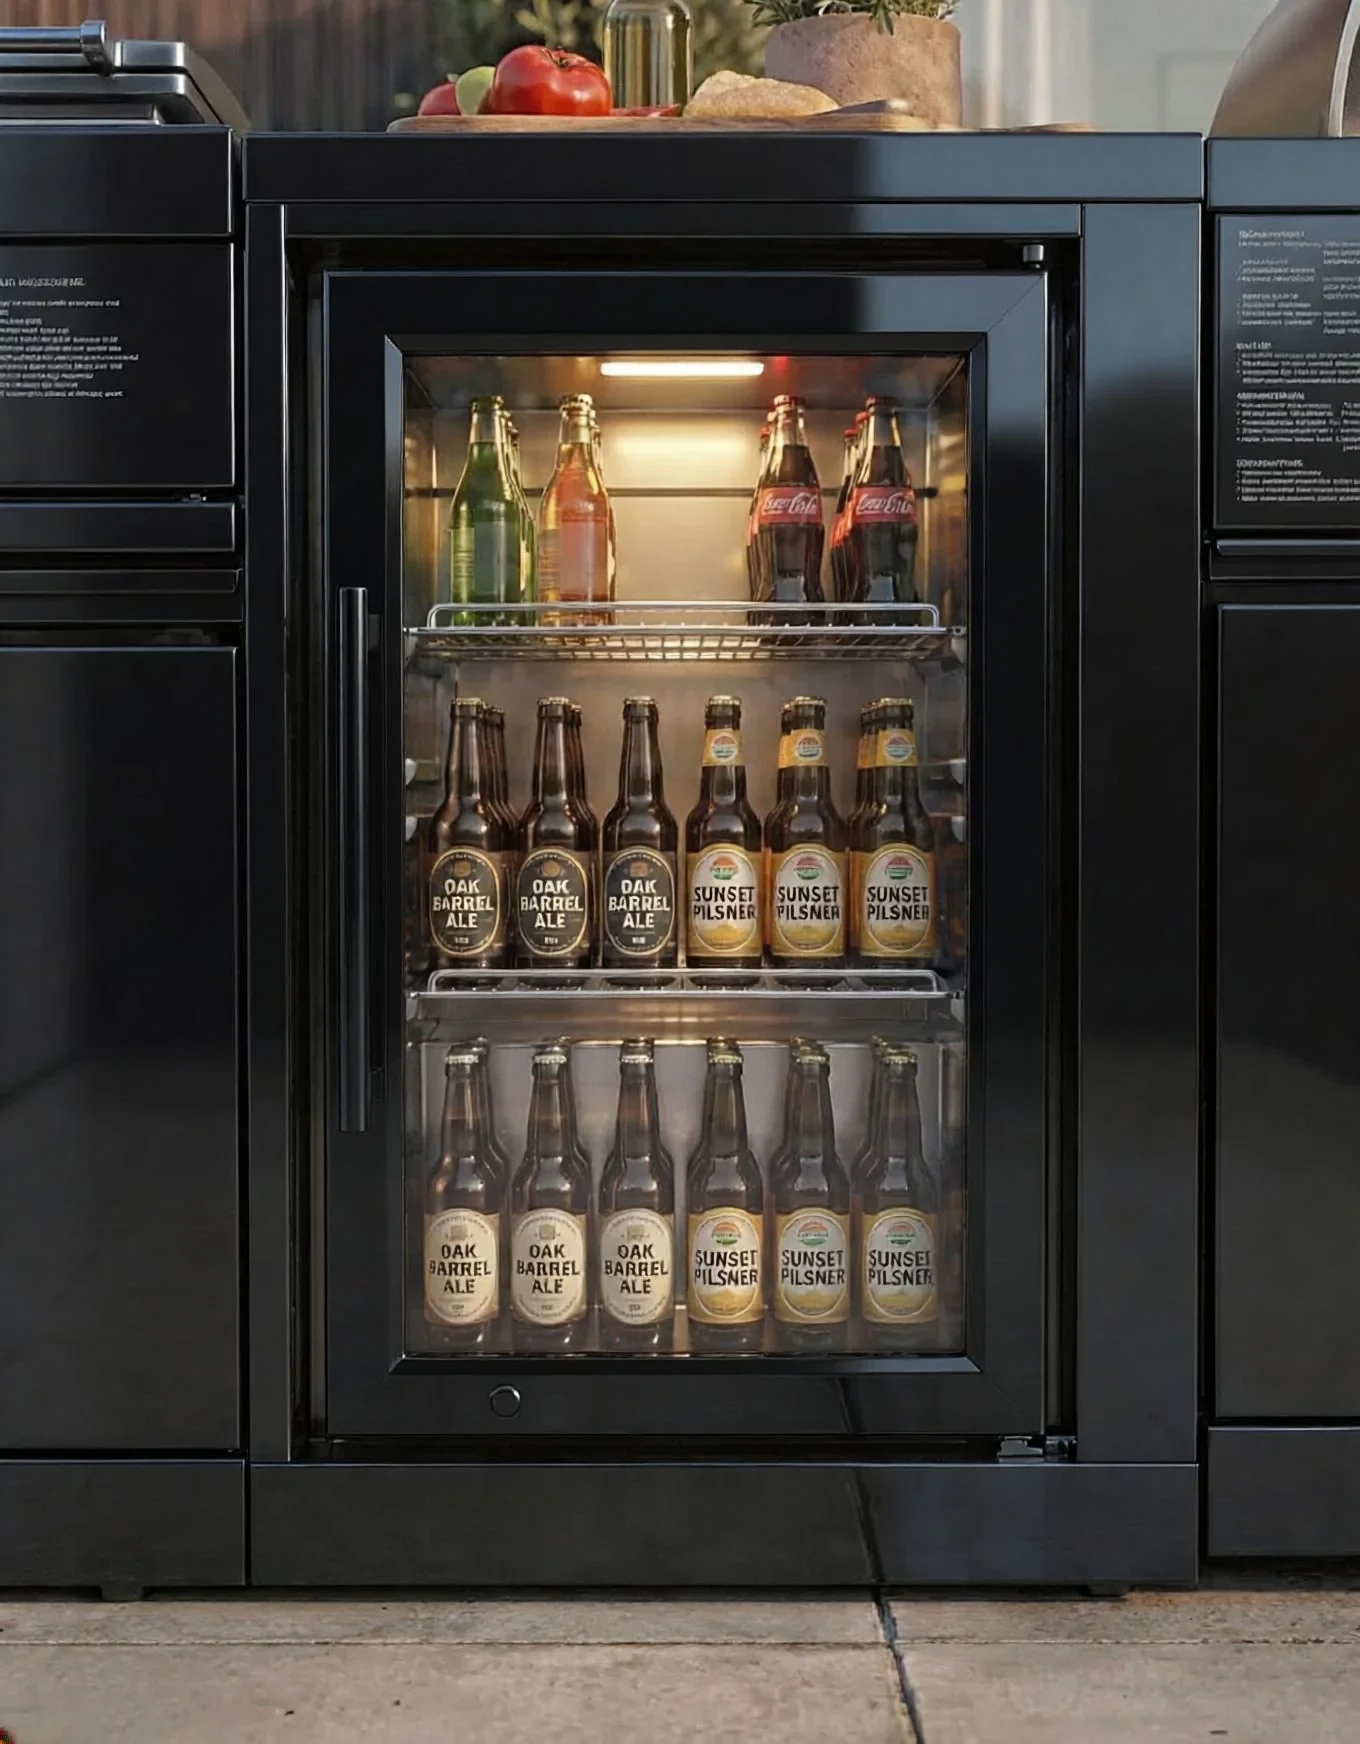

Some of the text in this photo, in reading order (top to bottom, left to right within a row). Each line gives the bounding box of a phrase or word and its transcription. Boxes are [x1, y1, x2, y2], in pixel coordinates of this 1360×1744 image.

[444, 879, 481, 894] OAK
[533, 879, 570, 894] OAK
[621, 879, 657, 894] OAK
[694, 886, 754, 902] SUNSET
[778, 886, 839, 902] SUNSET
[867, 886, 928, 902] SUNSET
[433, 896, 494, 912] BARREL
[521, 896, 583, 912] BARREL
[608, 896, 670, 912] BARREL
[694, 904, 756, 920] PILSNER
[778, 904, 840, 920] PILSNER
[868, 904, 929, 920] PILSNER
[446, 913, 478, 928] ALE
[534, 913, 566, 928] ALE
[623, 913, 655, 928] ALE
[441, 1244, 477, 1259] OAK
[529, 1244, 565, 1259] OAK
[618, 1244, 654, 1259] OAK
[696, 1250, 757, 1267] SUNSET
[782, 1250, 843, 1267] SUNSET
[869, 1250, 930, 1267] SUNSET
[429, 1262, 491, 1276] BARREL
[517, 1261, 580, 1276] BARREL
[605, 1260, 668, 1276] BARREL
[694, 1269, 757, 1286] PILSNER
[782, 1270, 845, 1285] PILSNER
[869, 1270, 932, 1286] PILSNER
[444, 1279, 475, 1294] ALE
[532, 1279, 563, 1294] ALE
[620, 1279, 652, 1294] ALE
